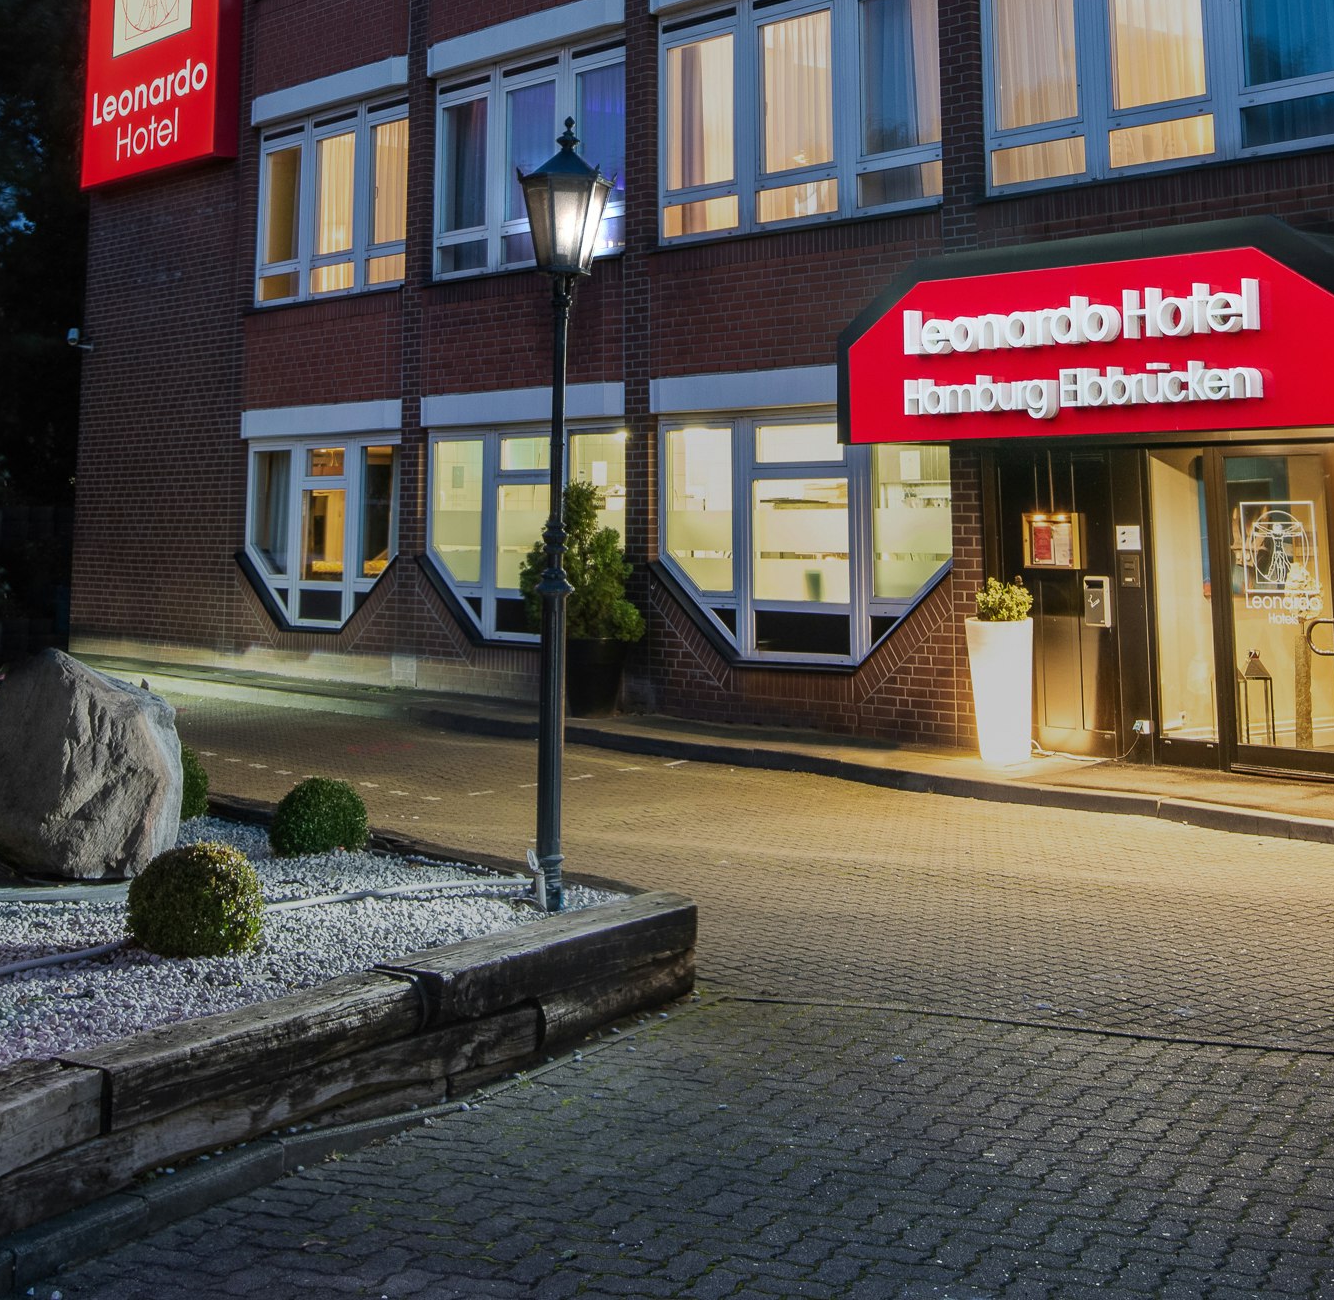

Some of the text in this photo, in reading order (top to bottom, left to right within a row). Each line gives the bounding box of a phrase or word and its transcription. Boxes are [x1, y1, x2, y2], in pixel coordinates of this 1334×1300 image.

[91, 58, 208, 127] Leonardo
[115, 107, 179, 162] Hotel
[902, 277, 1261, 356] Leonardo Hotel
[903, 360, 1264, 420] Hamburg Elbbrücken
[1245, 592, 1321, 611] Leonardo
